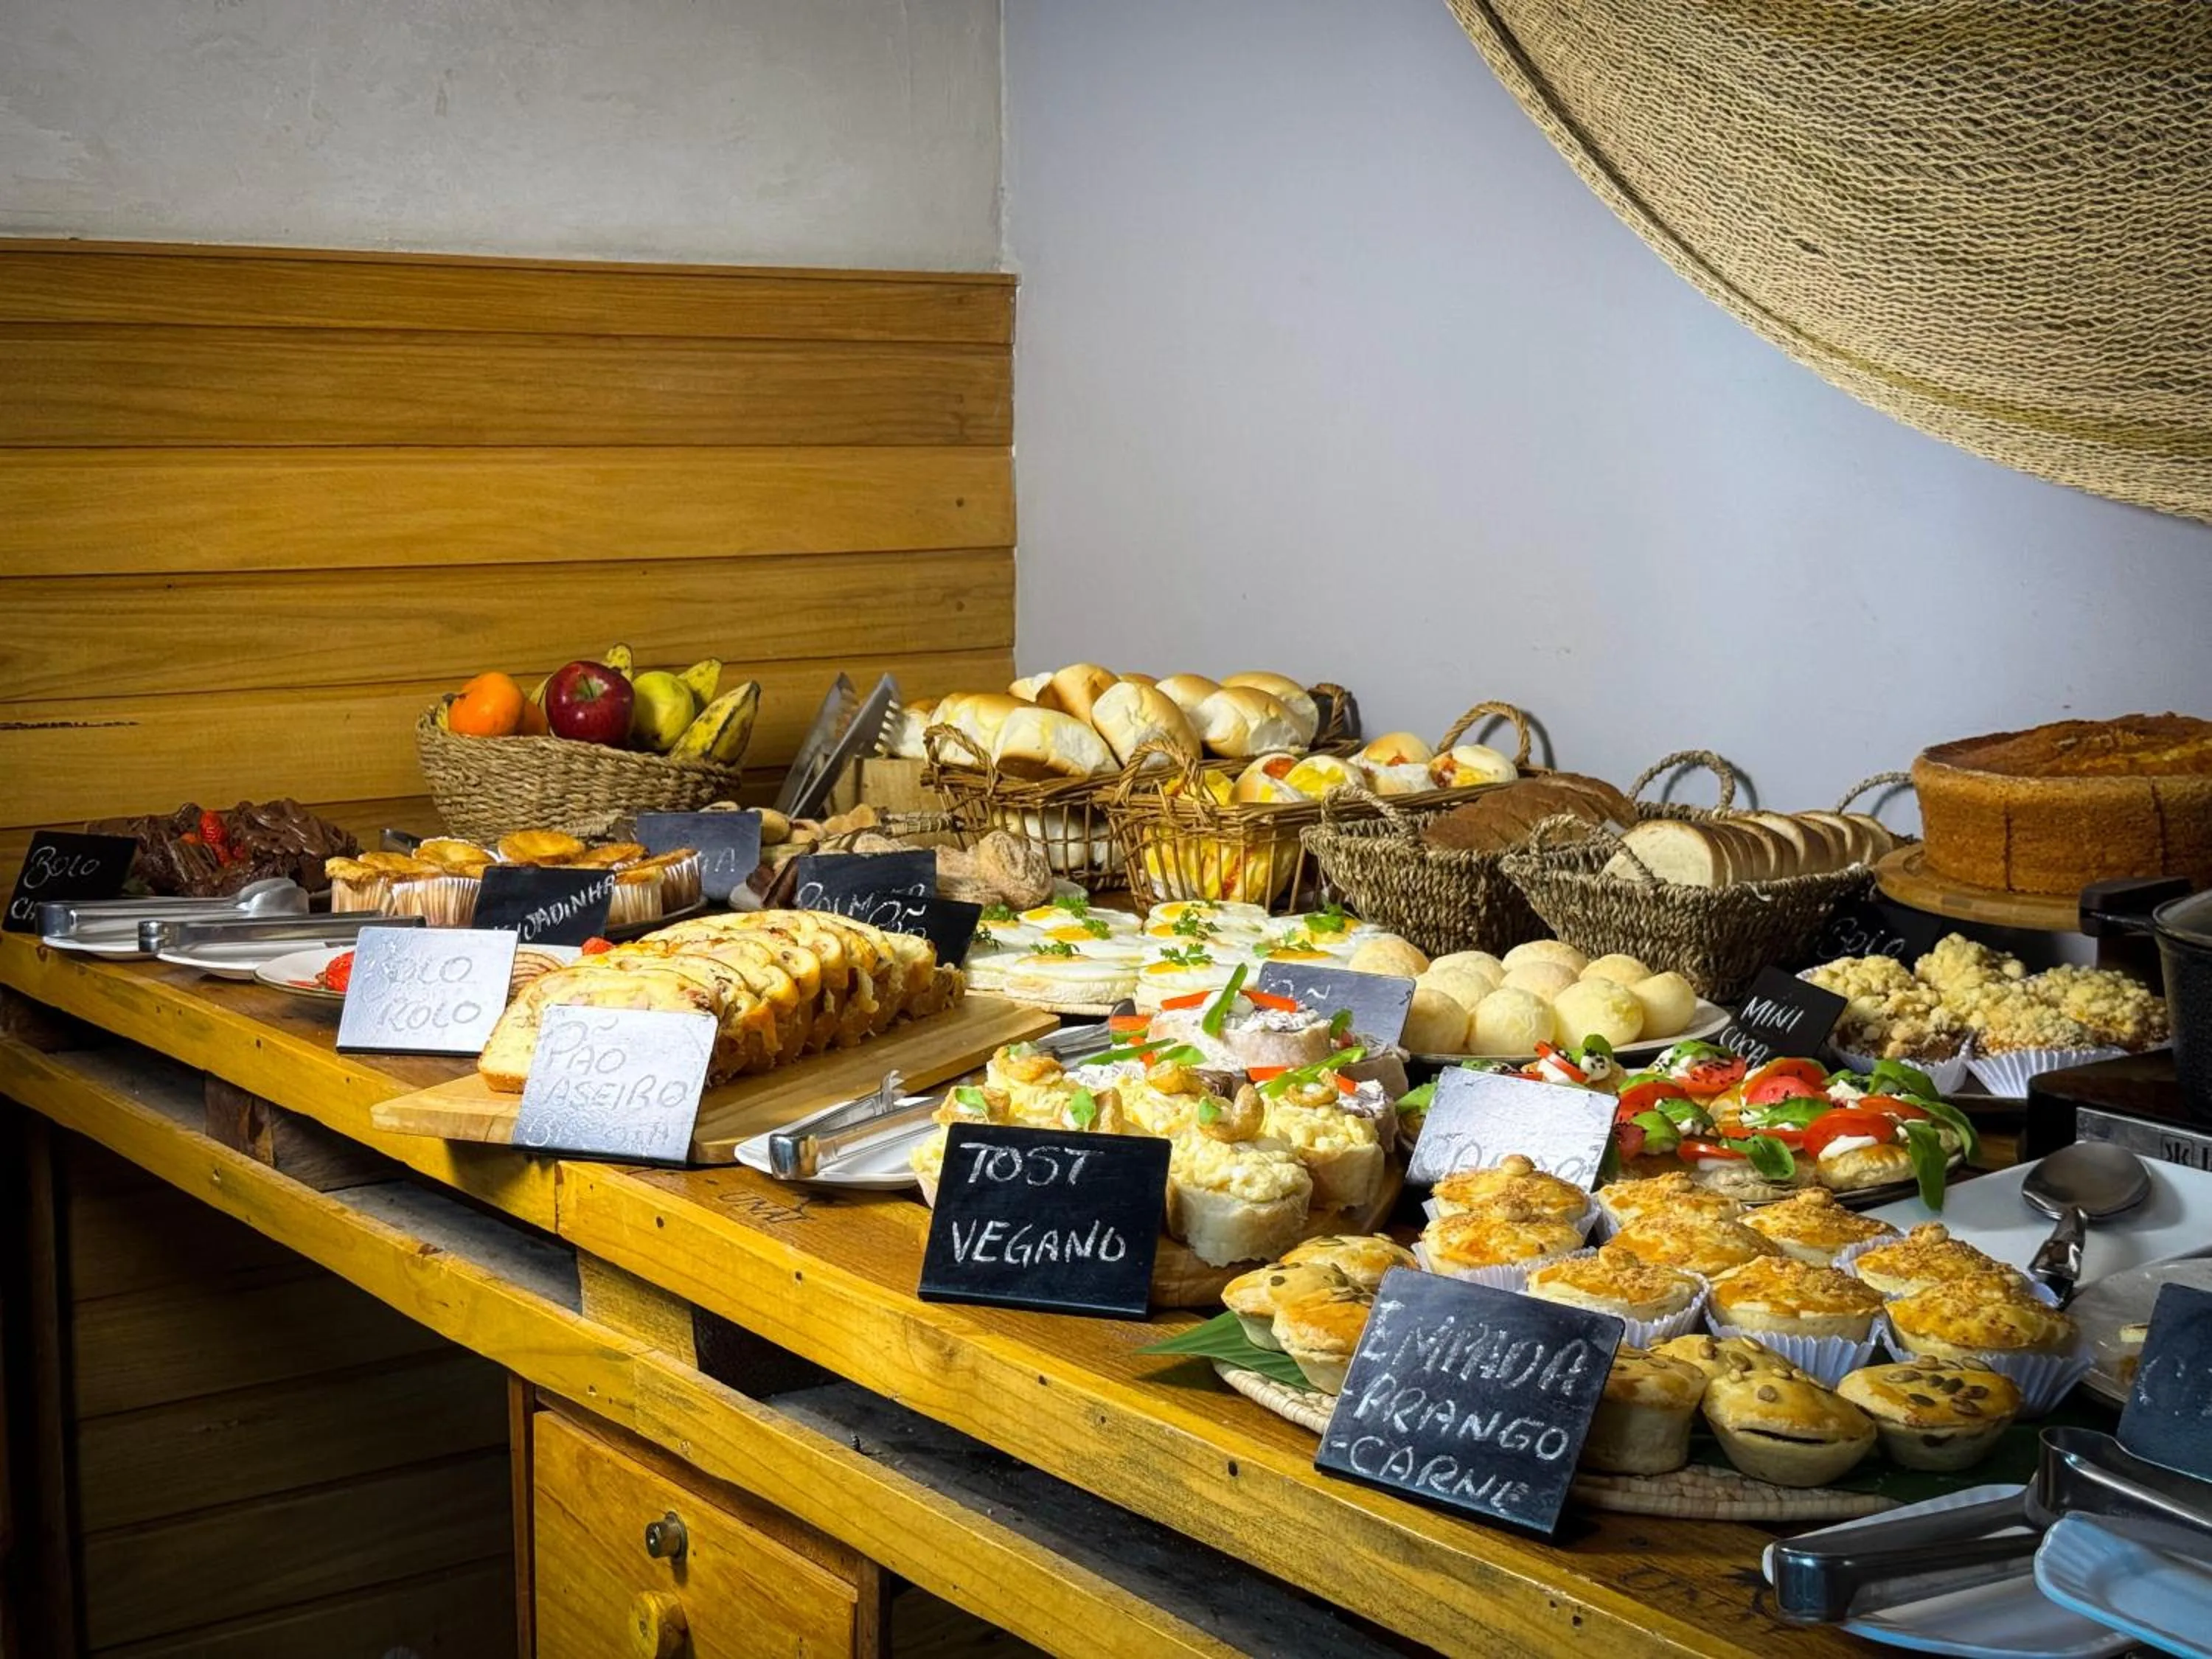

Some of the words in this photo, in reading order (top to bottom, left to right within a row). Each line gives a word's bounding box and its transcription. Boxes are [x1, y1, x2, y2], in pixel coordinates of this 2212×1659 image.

[1739, 996, 1805, 1034] MINI
[541, 1015, 627, 1075] PÃO
[959, 1142, 1105, 1186] TOST
[951, 1220, 1127, 1268] VEGANO
